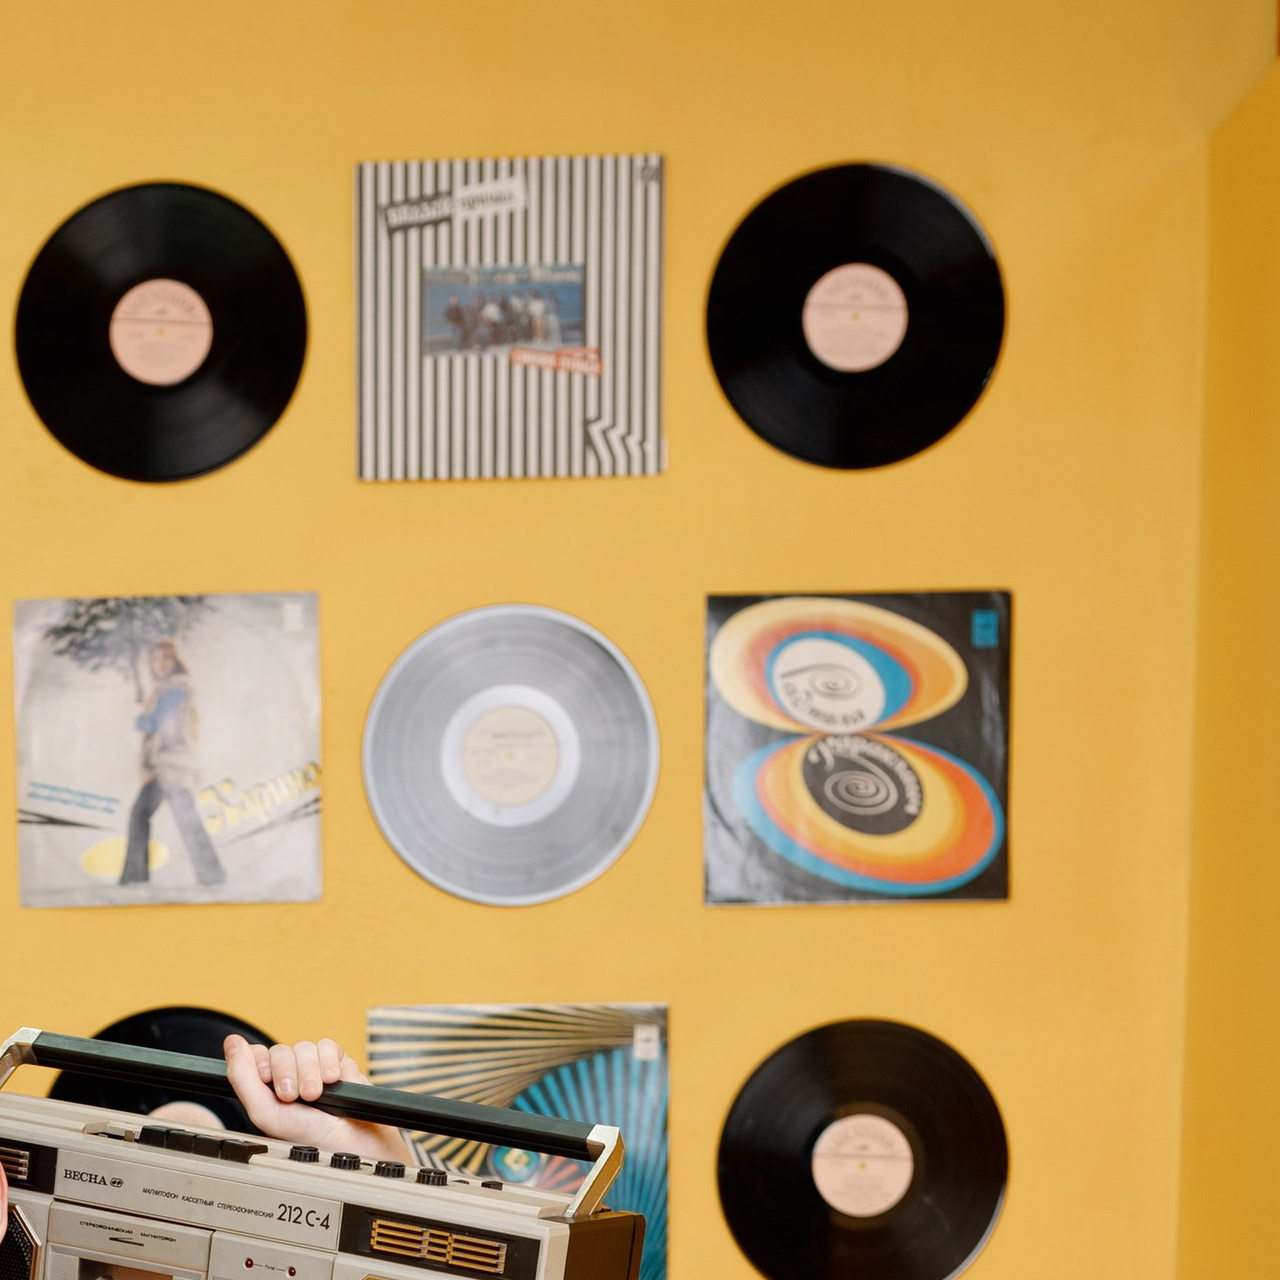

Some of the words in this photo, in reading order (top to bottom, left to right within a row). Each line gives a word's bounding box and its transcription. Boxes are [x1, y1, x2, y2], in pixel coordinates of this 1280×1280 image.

[63, 1168, 108, 1186] ВЕСНА
[142, 1187, 179, 1199] МАГНИТОФОН
[181, 1195, 215, 1207] КАССЕТНЫЙ
[216, 1202, 274, 1218] СТЕРЕОФОНИЧЕСКИЙ
[277, 1203, 303, 1225] 212
[79, 1220, 134, 1235] СТЕРЕОФОНИЧЕСКИЙ
[140, 1232, 176, 1243] МАГНИТОФОН
